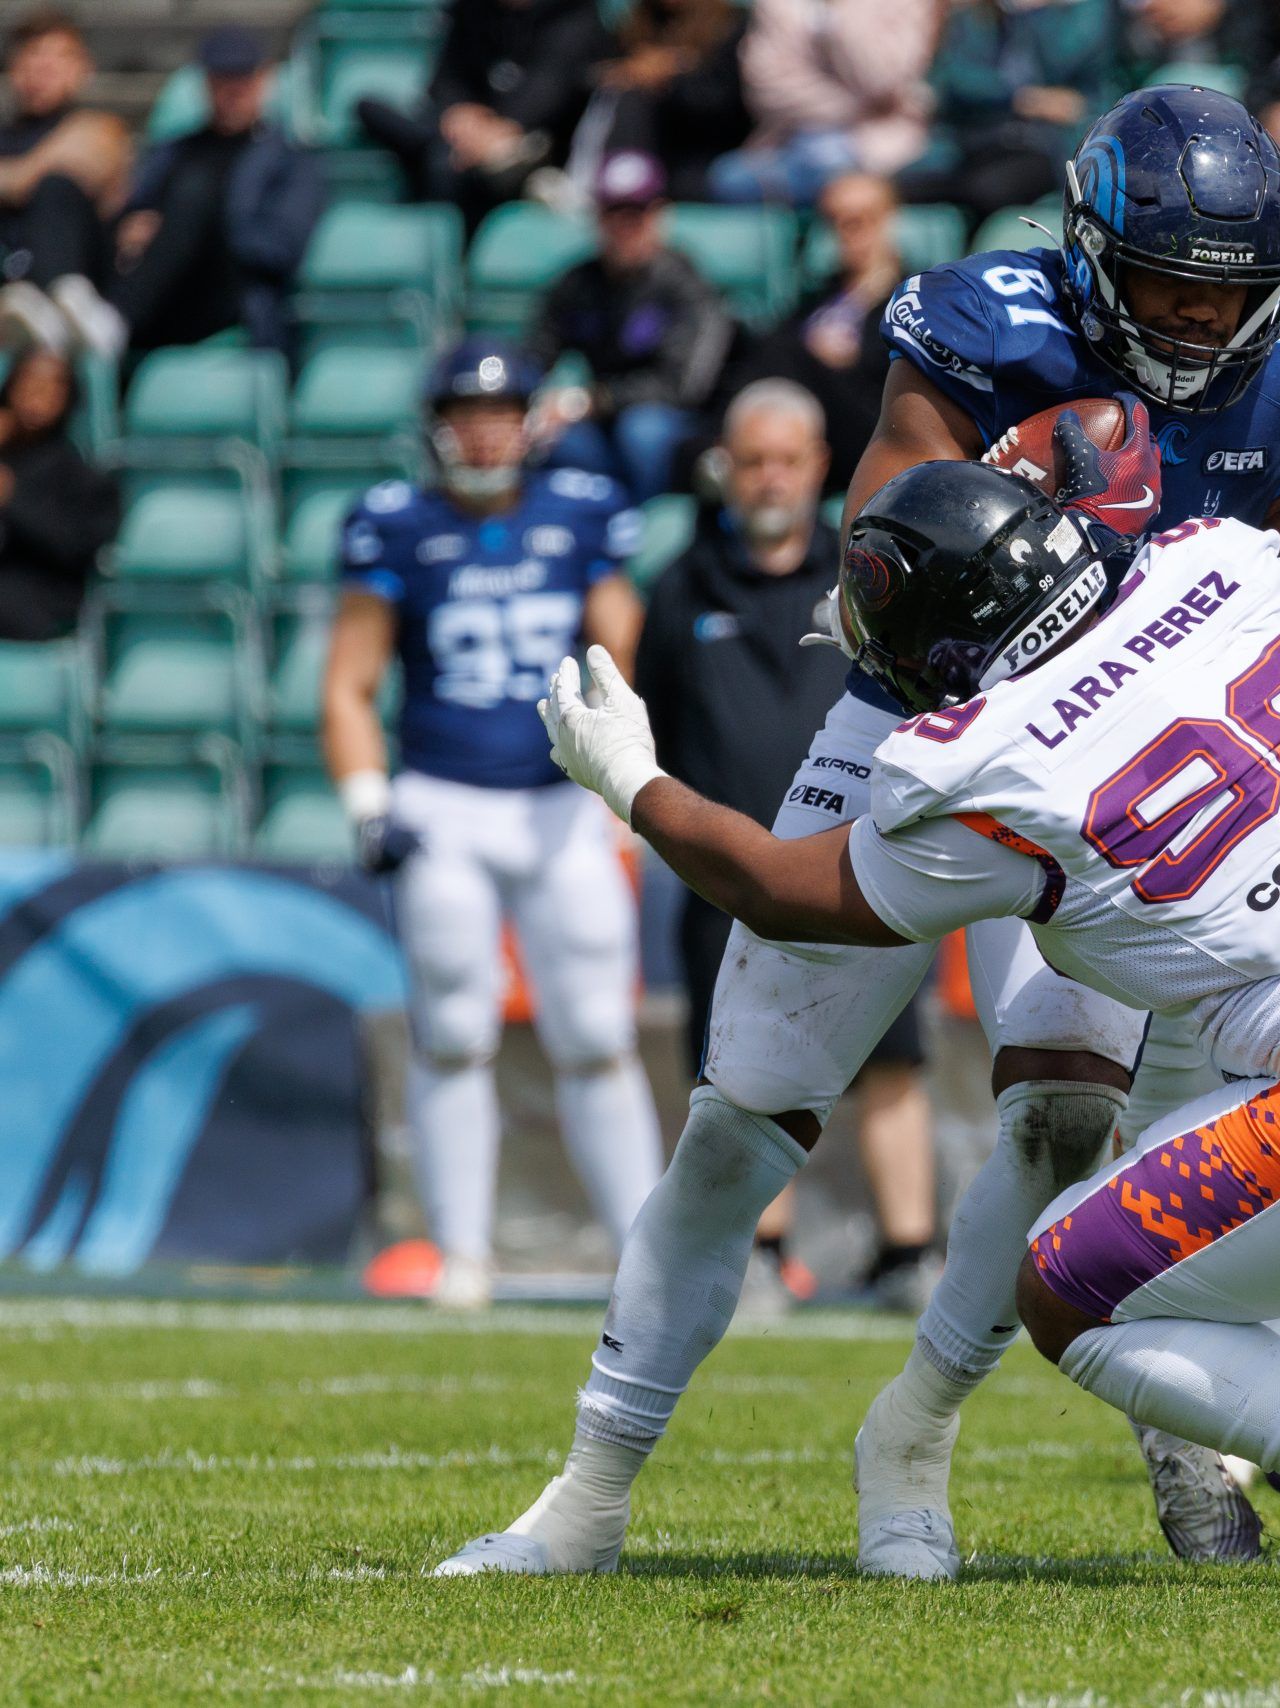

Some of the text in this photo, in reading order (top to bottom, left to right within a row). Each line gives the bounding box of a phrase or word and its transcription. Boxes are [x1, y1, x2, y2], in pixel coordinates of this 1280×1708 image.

[1190, 248, 1255, 264] FORELLE
[1166, 371, 1196, 384] Rddell
[1223, 450, 1264, 471] EFA
[1038, 574, 1054, 592] 99
[1003, 565, 1106, 672] FORELLE
[1025, 570, 1241, 749] LARA PEREZ
[801, 786, 845, 815] EFA
